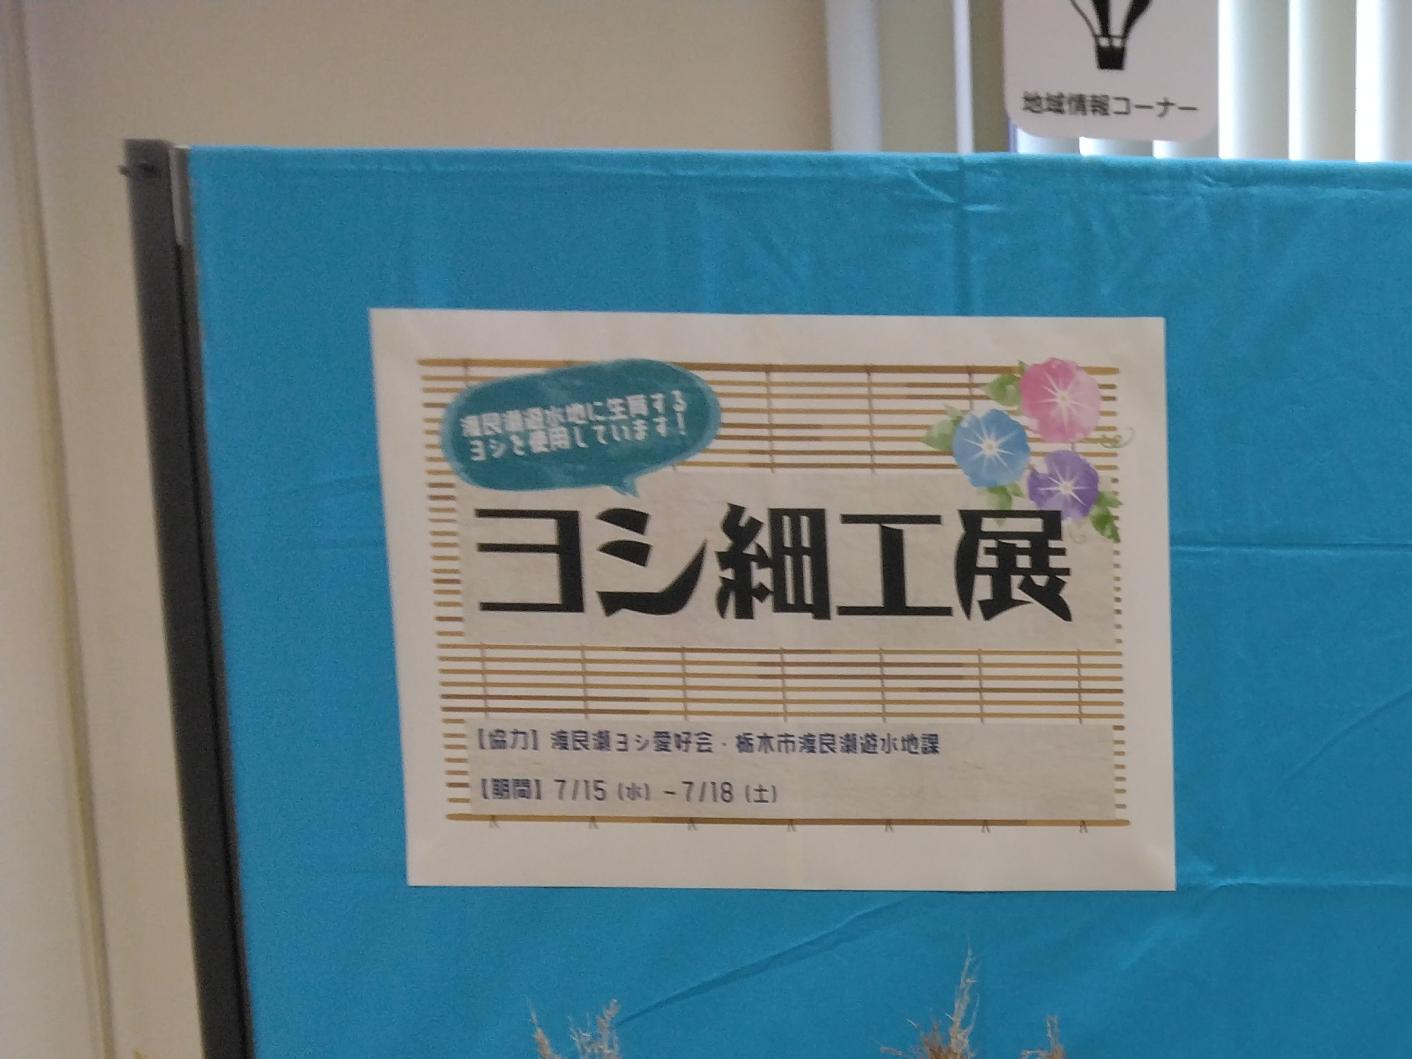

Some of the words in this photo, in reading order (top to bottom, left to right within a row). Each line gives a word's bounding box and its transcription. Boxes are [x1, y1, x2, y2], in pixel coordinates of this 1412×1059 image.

[1022, 91, 1198, 118] 地域情報コーナー
[474, 502, 1073, 622] ヨシ細工展
